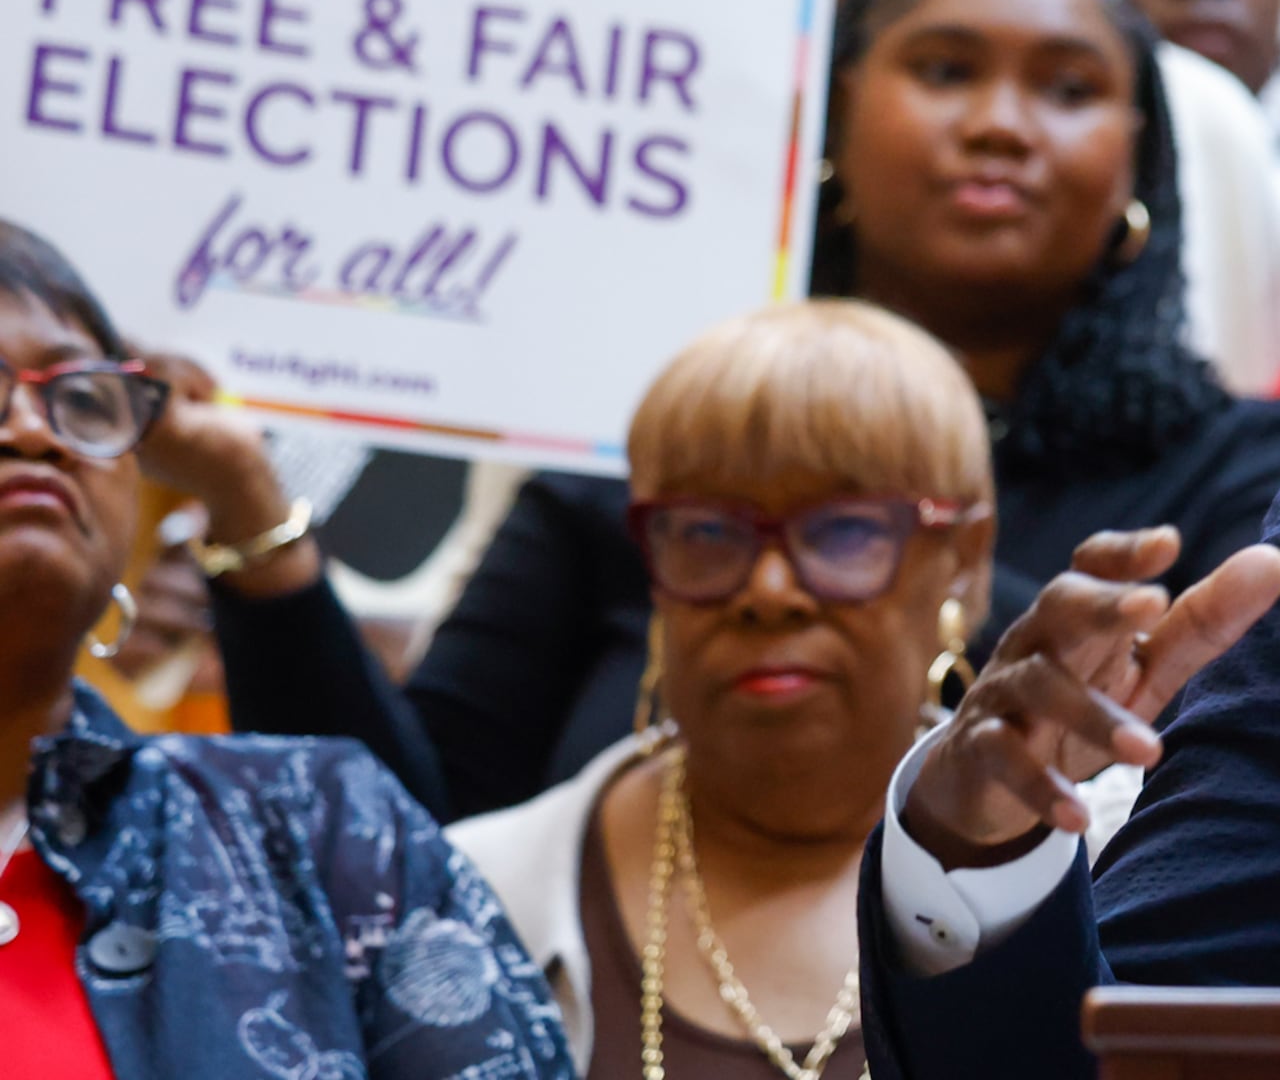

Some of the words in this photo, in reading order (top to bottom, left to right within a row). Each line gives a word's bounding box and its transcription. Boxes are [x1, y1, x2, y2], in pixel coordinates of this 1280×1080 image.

[464, 3, 705, 114] FAIR
[23, 42, 695, 221] ELECTIONS
[173, 192, 322, 311] for
[338, 223, 519, 317] all!
[229, 349, 436, 394] fairfight.com
